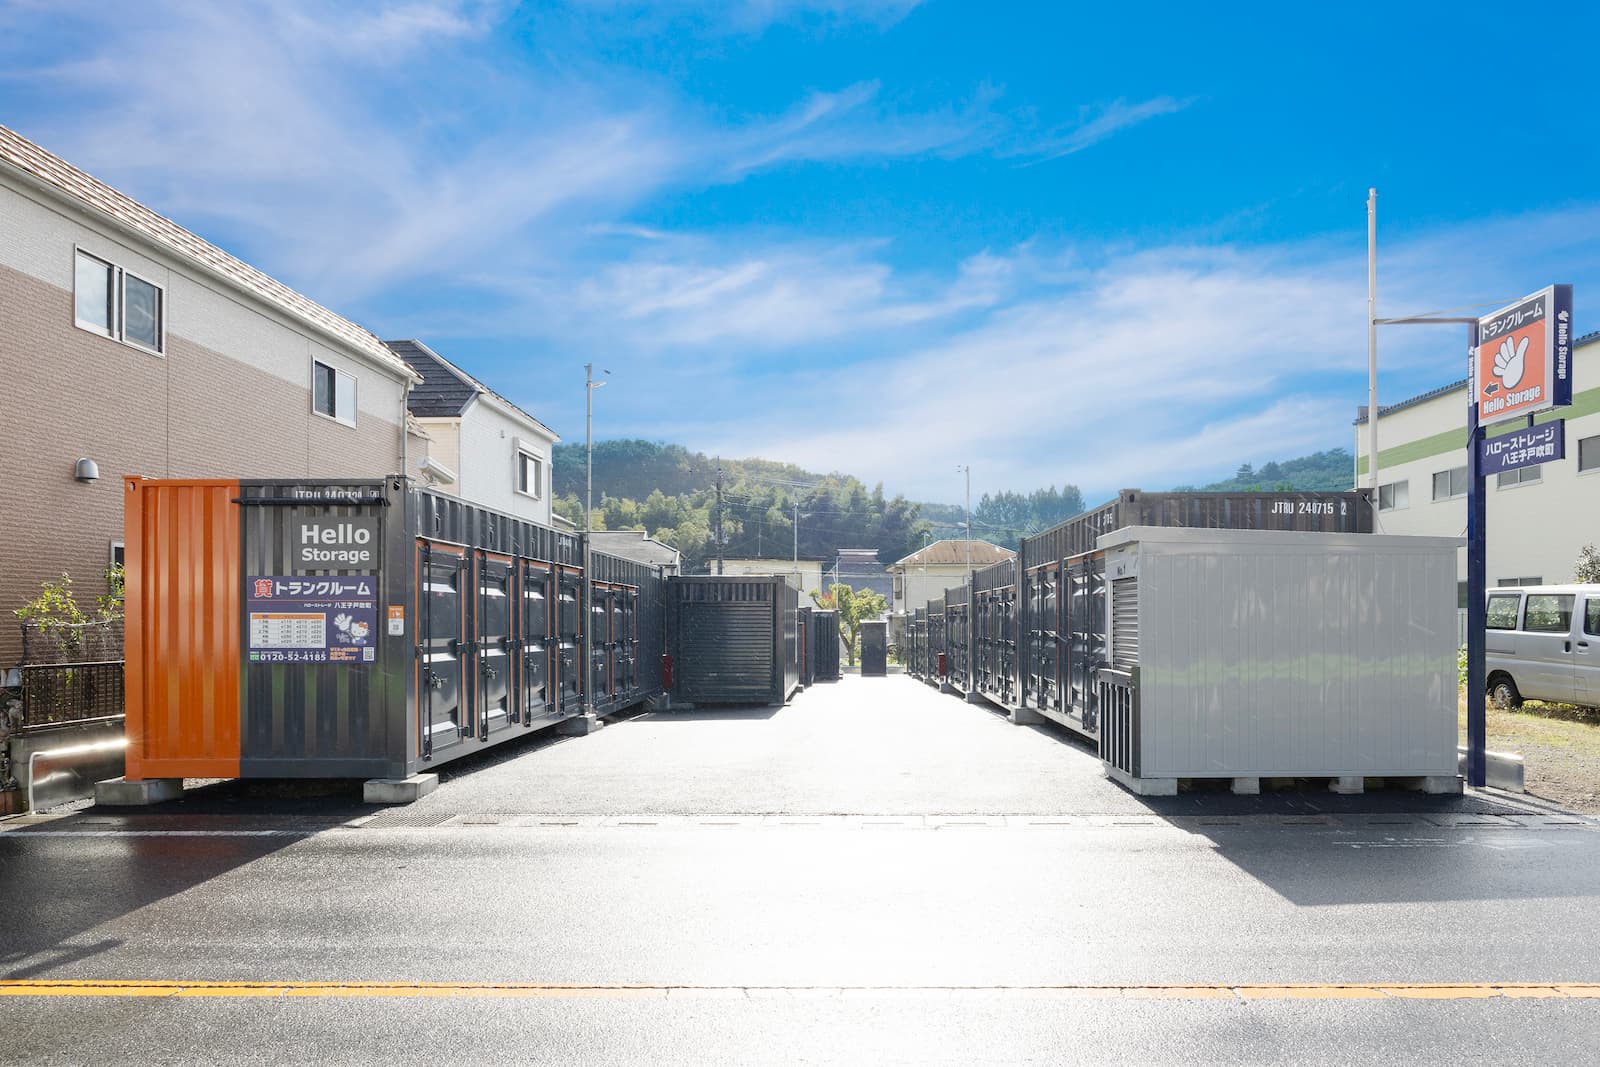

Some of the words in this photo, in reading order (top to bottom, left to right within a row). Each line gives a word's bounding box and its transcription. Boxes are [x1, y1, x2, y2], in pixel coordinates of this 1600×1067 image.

[1482, 303, 1543, 340] トランクルーム
[1558, 323, 1567, 345] Hello
[1558, 347, 1568, 380] Storage
[1483, 396, 1504, 415] Hello
[1506, 386, 1541, 408] Storage
[1486, 427, 1554, 456] ハローストレージ
[1502, 443, 1554, 467] 八王子戸吹町
[1271, 501, 1294, 514] JTRU
[1299, 502, 1334, 514] 240715
[301, 524, 370, 544] Hello
[301, 548, 370, 564] Storage
